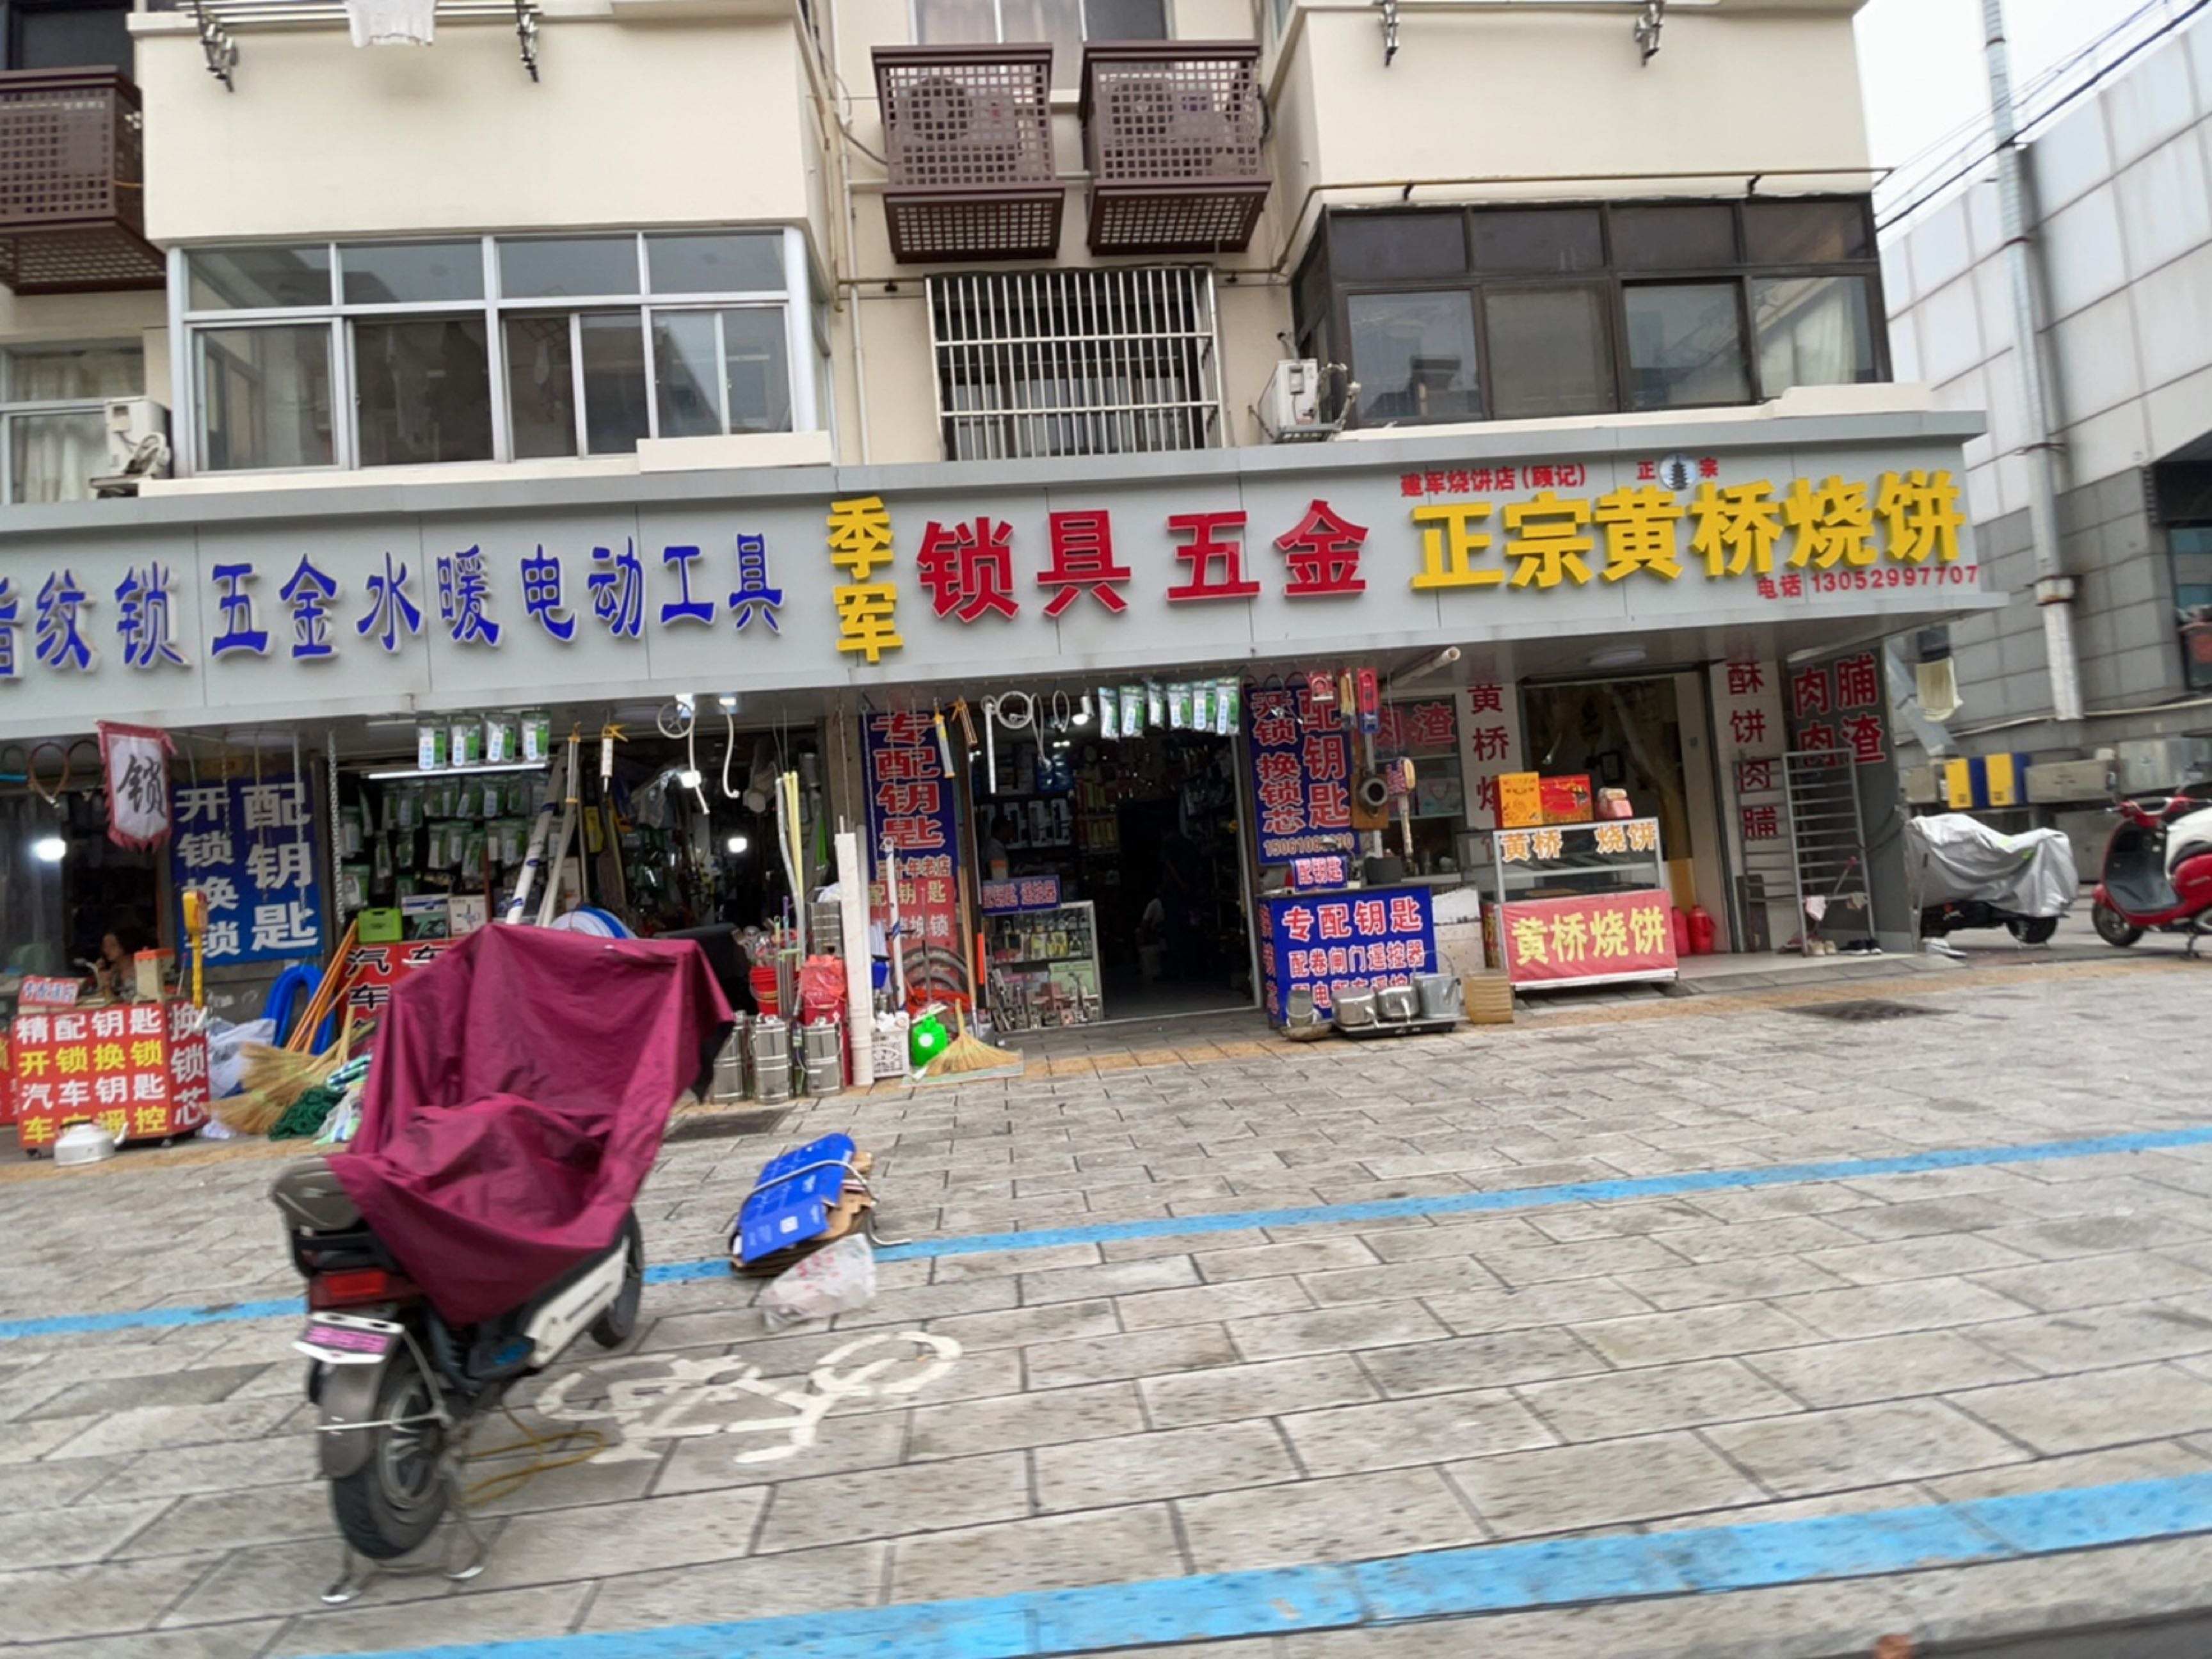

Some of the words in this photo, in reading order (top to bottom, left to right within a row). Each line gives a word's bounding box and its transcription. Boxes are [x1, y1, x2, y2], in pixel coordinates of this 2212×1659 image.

[1637, 461, 1656, 480] 正
[1699, 457, 1719, 478] 宗
[1411, 469, 1966, 589] 正宗黄桥烧饼
[826, 496, 902, 663] 季军
[917, 499, 1368, 623] 锁具五金
[1756, 573, 1802, 600] 电话
[1811, 565, 1978, 593] 13052997707
[1793, 652, 1878, 717] 肉脯
[1297, 691, 1351, 829] 配钥匙
[1798, 712, 1886, 768] 肉渣
[871, 711, 947, 851] 专配钥匙
[174, 787, 241, 958] 开锁换锁
[240, 782, 319, 952] 配钥匙
[1500, 830, 1563, 862] 黄桥
[1594, 822, 1656, 853] 烧饼
[1282, 895, 1423, 942] 专配钥匙
[1512, 906, 1666, 965] 黄桥烧饼
[16, 1007, 161, 1045] 精配钥匙
[18, 1039, 164, 1078] 开锁换锁
[168, 1002, 209, 1126] 换锁芯
[22, 1073, 166, 1111] 汽车钥匙
